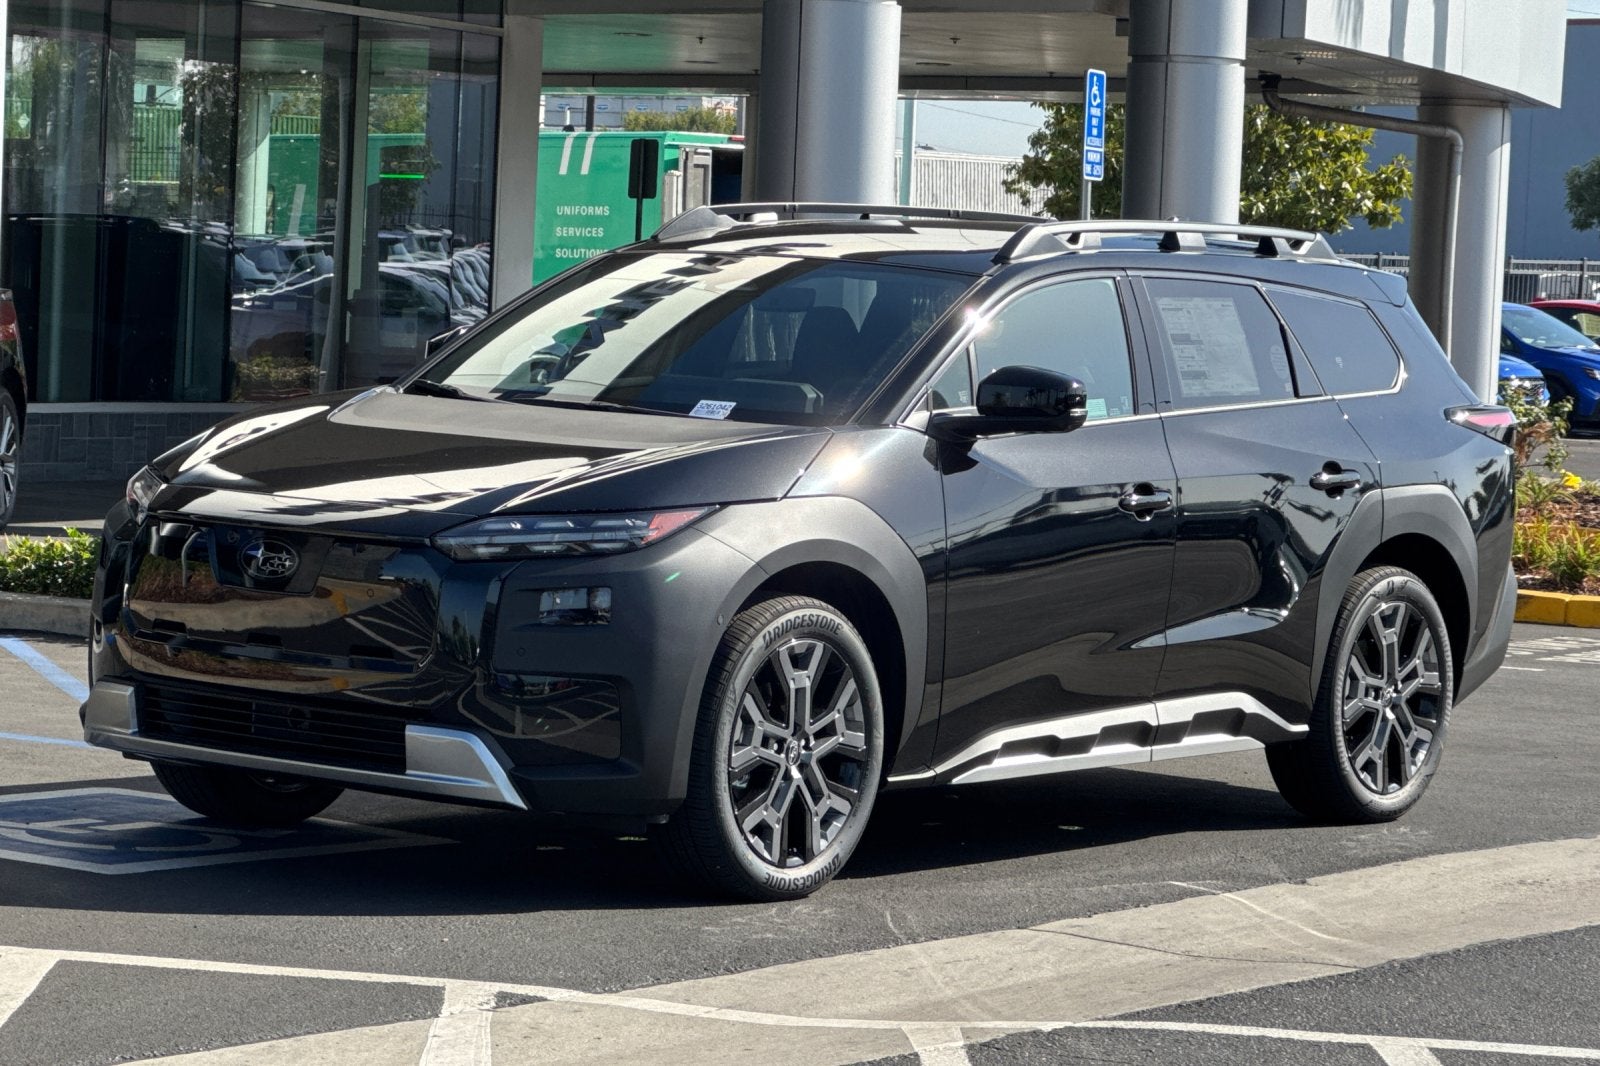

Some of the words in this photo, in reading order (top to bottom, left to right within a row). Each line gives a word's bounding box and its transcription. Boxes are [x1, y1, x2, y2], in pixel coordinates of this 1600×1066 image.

[556, 205, 610, 216] UNIFORMS
[555, 226, 604, 237] SERVICES
[762, 613, 842, 651] BRIDGESTONE
[761, 853, 842, 892] BRIDGESTONE
